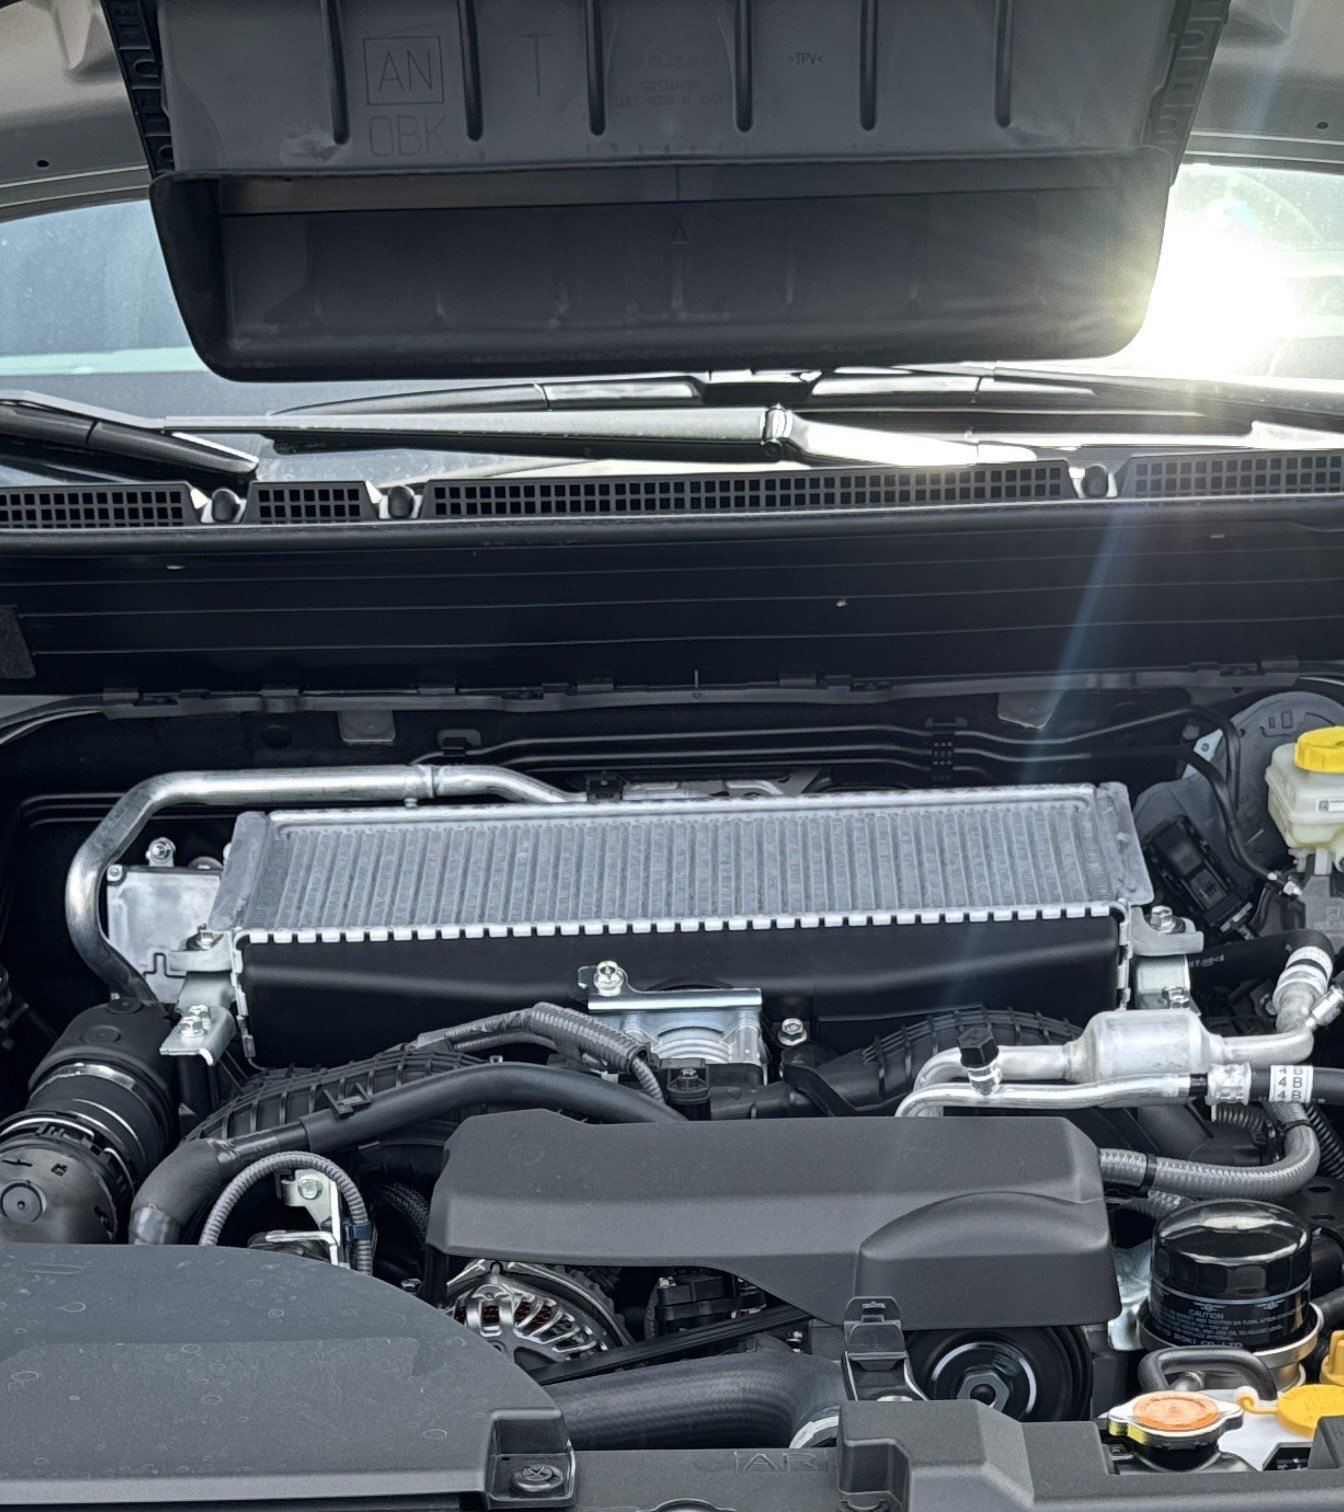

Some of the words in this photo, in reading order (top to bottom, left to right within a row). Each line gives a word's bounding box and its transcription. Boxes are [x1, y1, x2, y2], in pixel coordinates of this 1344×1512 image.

[378, 50, 433, 92] AN
[369, 112, 449, 156] OBK
[1188, 1308, 1225, 1320] CAUTION
